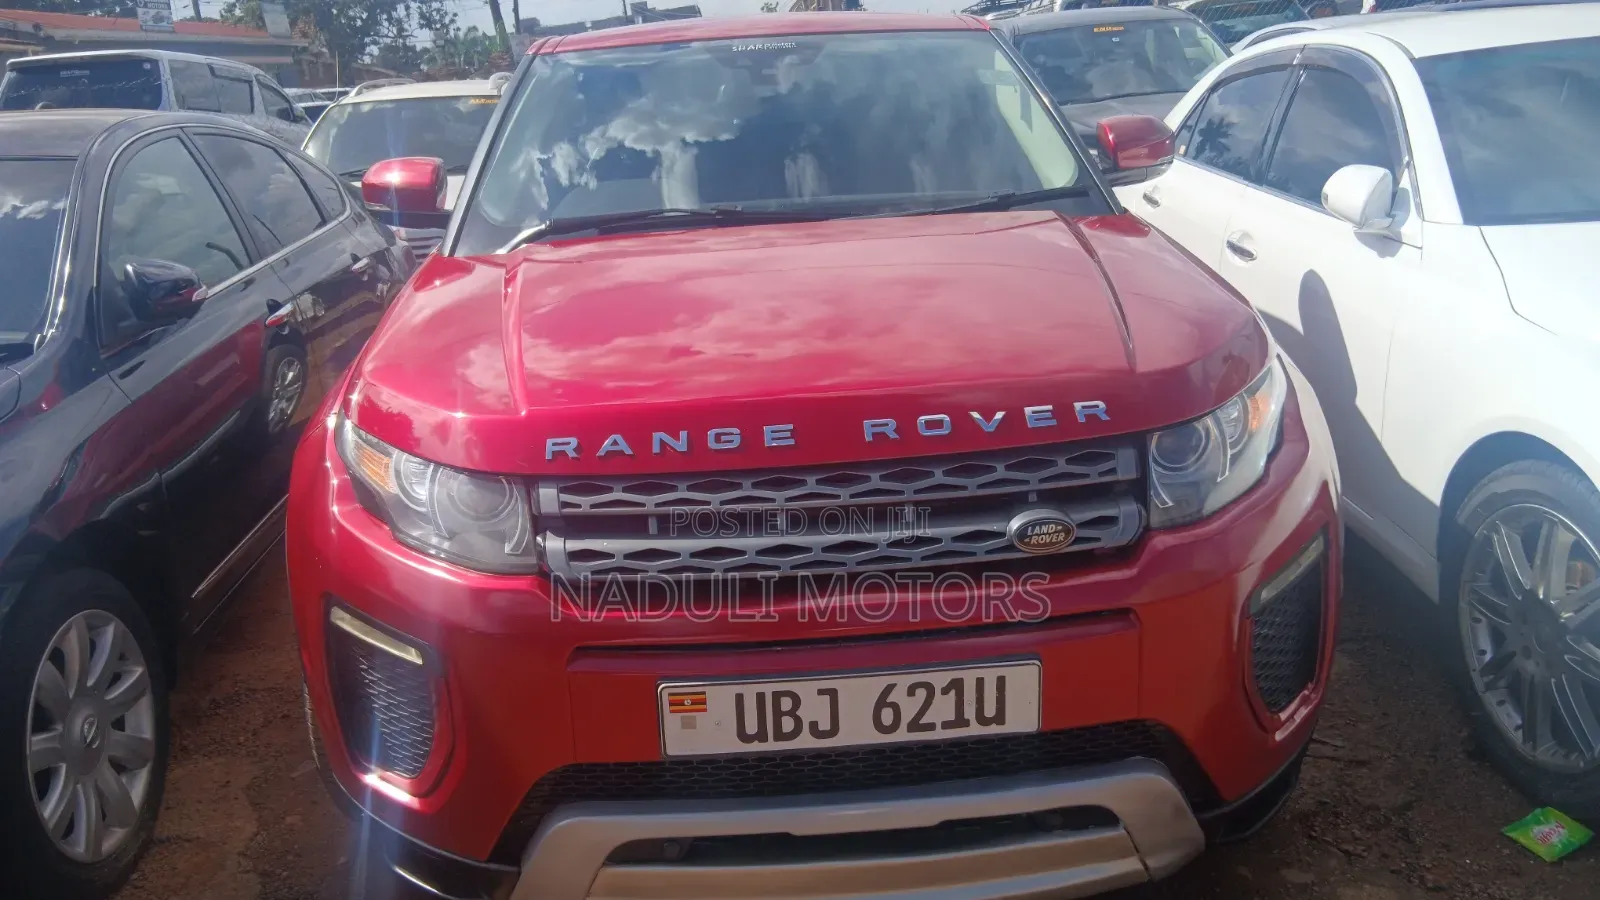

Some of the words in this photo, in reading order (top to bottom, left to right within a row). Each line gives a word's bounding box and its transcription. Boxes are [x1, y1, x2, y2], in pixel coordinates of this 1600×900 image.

[545, 424, 795, 460] RANGE
[863, 400, 1111, 442] ROVER
[1027, 524, 1058, 536] LAND
[1029, 532, 1065, 545] ROVER
[735, 687, 840, 744] UBJ
[872, 676, 1006, 735] 621U
